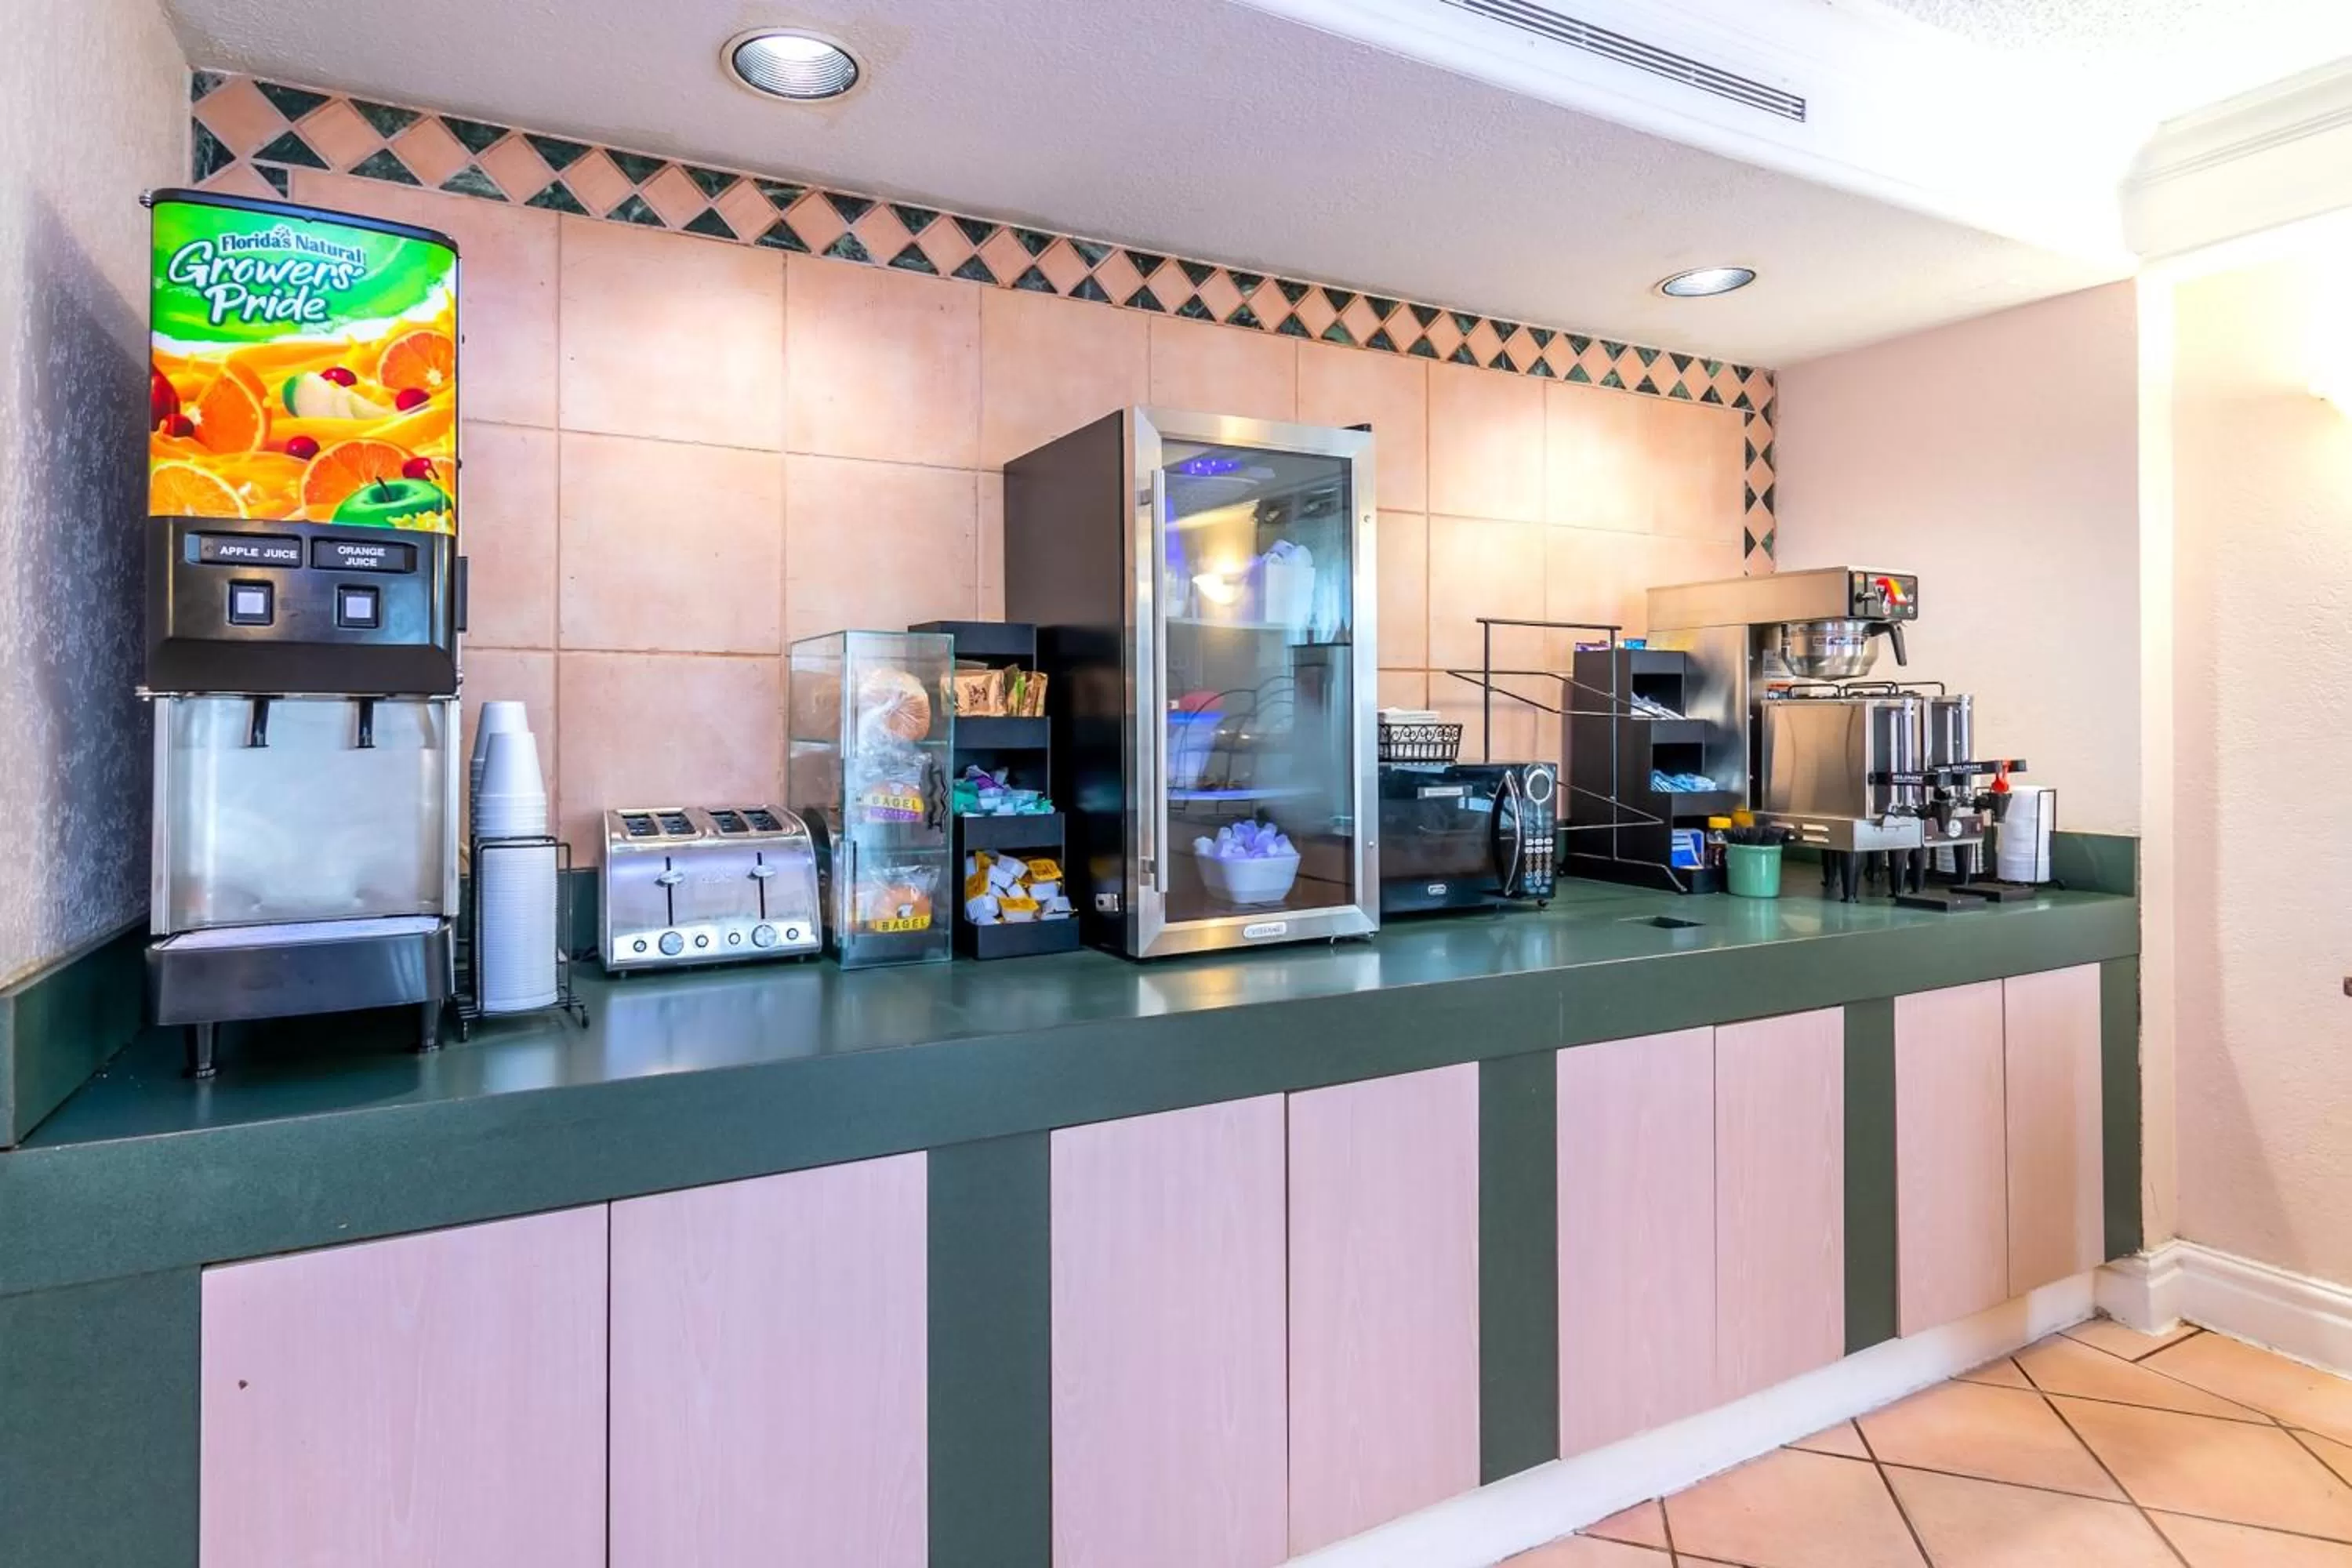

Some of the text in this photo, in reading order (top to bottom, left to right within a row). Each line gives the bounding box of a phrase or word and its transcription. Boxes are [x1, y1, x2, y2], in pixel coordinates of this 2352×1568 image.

[296, 235, 361, 263] Natural
[203, 282, 327, 325] Pride
[220, 546, 298, 559] APPLE JUICE
[337, 546, 386, 557] ORANGE
[345, 557, 377, 567] JUICE
